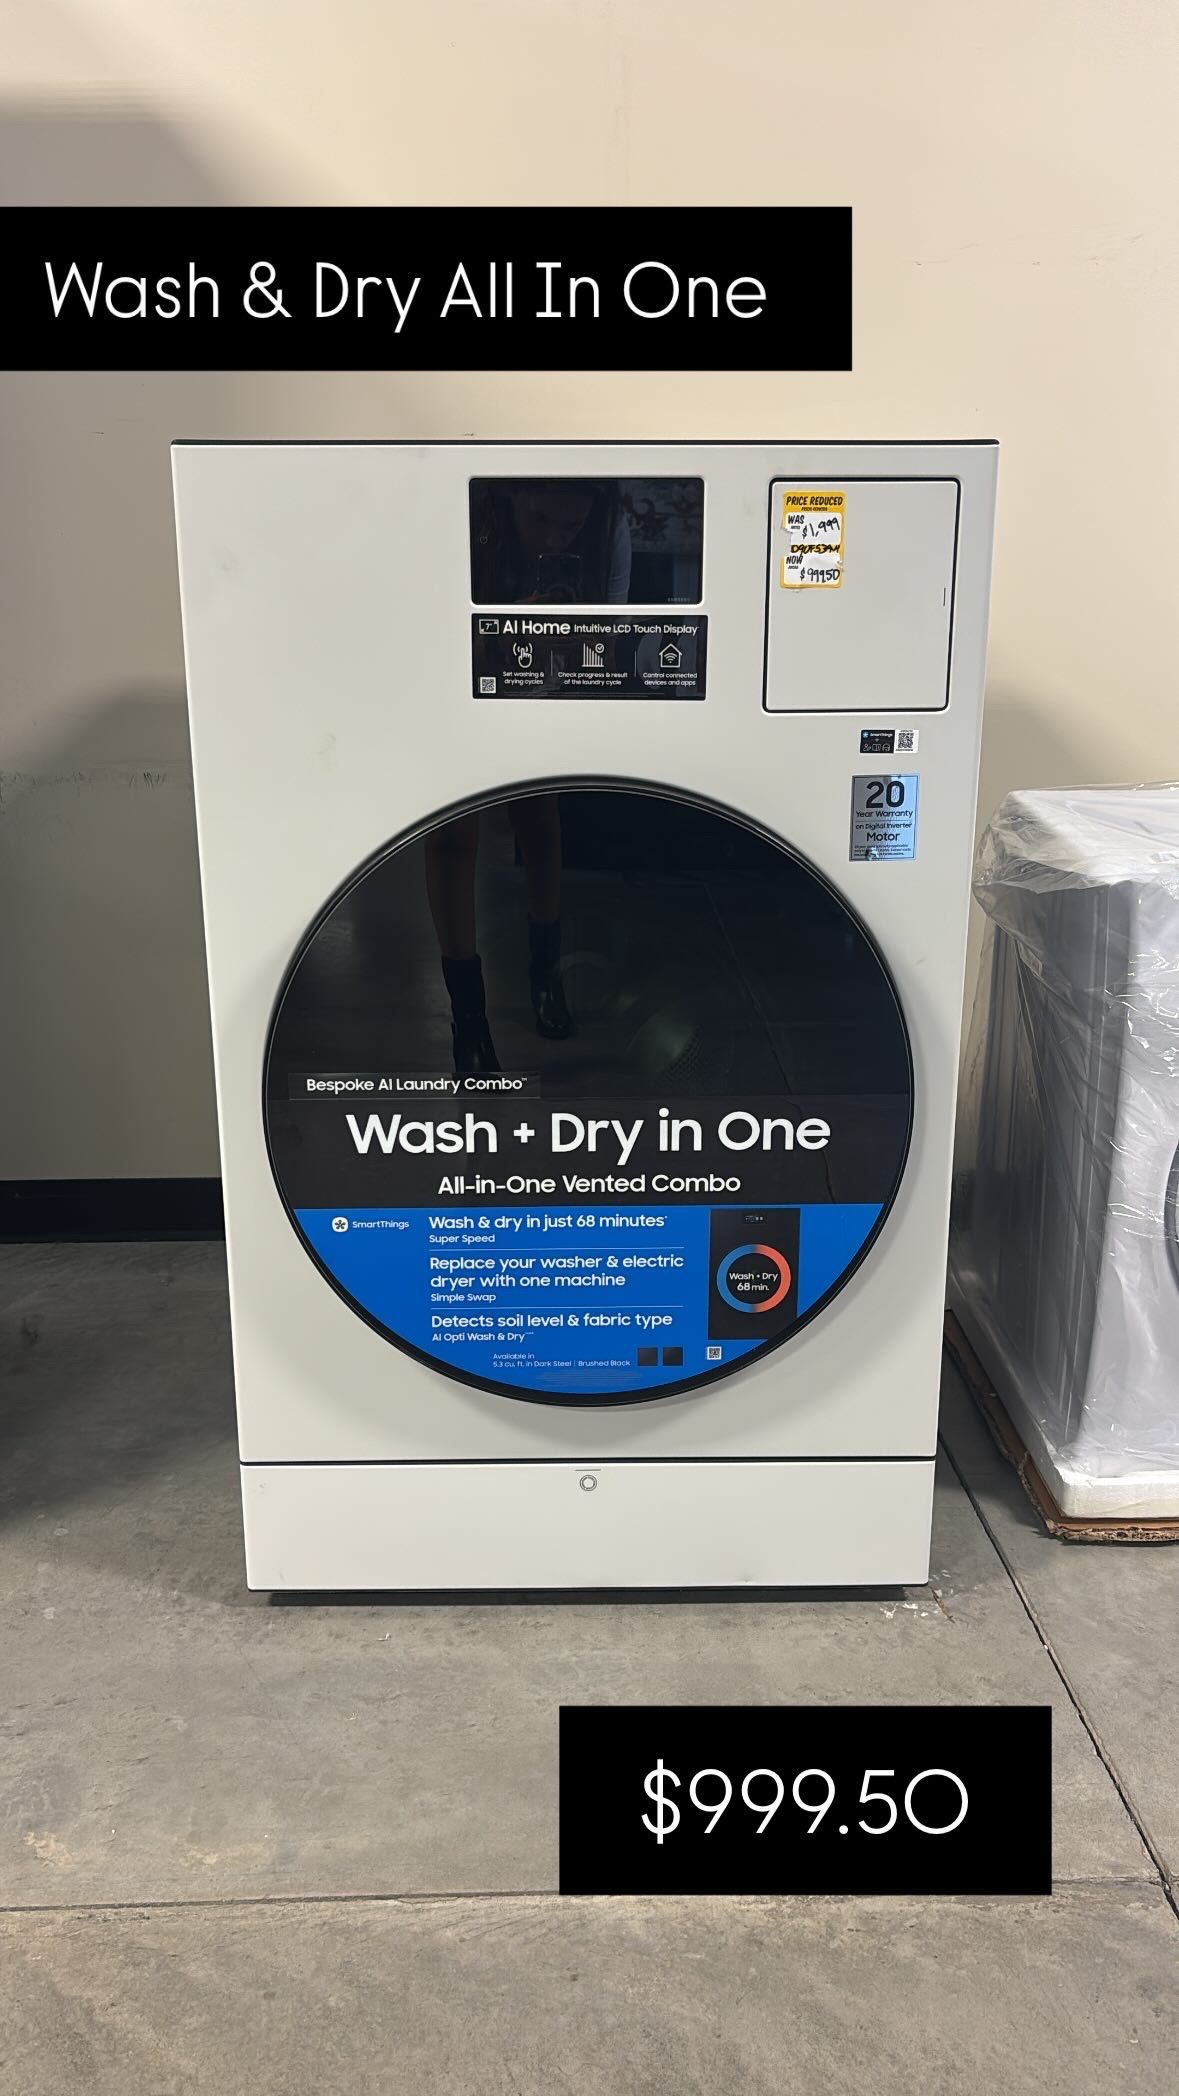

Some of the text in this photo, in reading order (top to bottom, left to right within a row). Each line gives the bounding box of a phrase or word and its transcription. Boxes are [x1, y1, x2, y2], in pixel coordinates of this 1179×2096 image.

[786, 496, 843, 505] PRICE REDUCED
[788, 515, 805, 524] WAS
[802, 517, 840, 539] $1,999
[786, 555, 803, 565] NOW
[503, 620, 570, 634] AI Home
[574, 624, 698, 636] Intuitive LCD Touch Display
[513, 671, 539, 680] washing
[578, 673, 604, 681] progress
[582, 679, 605, 687] laundry
[866, 781, 905, 808] 20
[876, 810, 913, 819] Warranty
[865, 823, 885, 831] Digital
[867, 832, 900, 842] Motor
[307, 1079, 374, 1094] Bespoke
[379, 1079, 392, 1090] AI
[397, 1078, 460, 1094] Laundry
[346, 1108, 830, 1165] Wash + Dry in One
[438, 1174, 740, 1194] All-in-One Vented Combo
[353, 1220, 409, 1229] SmartThings
[429, 1214, 664, 1232] Wash & dry in just 68 minutes
[429, 1234, 495, 1245] Super Speed
[430, 1254, 683, 1273] Replace your washer & electric
[431, 1273, 625, 1291] dryer with one machine
[762, 1273, 778, 1281] Dry
[737, 1283, 750, 1291] 68
[431, 1293, 496, 1303] Simple Swap
[432, 1313, 672, 1329] Detects soil level & fabric type
[444, 1332, 465, 1343] Opti
[507, 1333, 525, 1343] Dry
